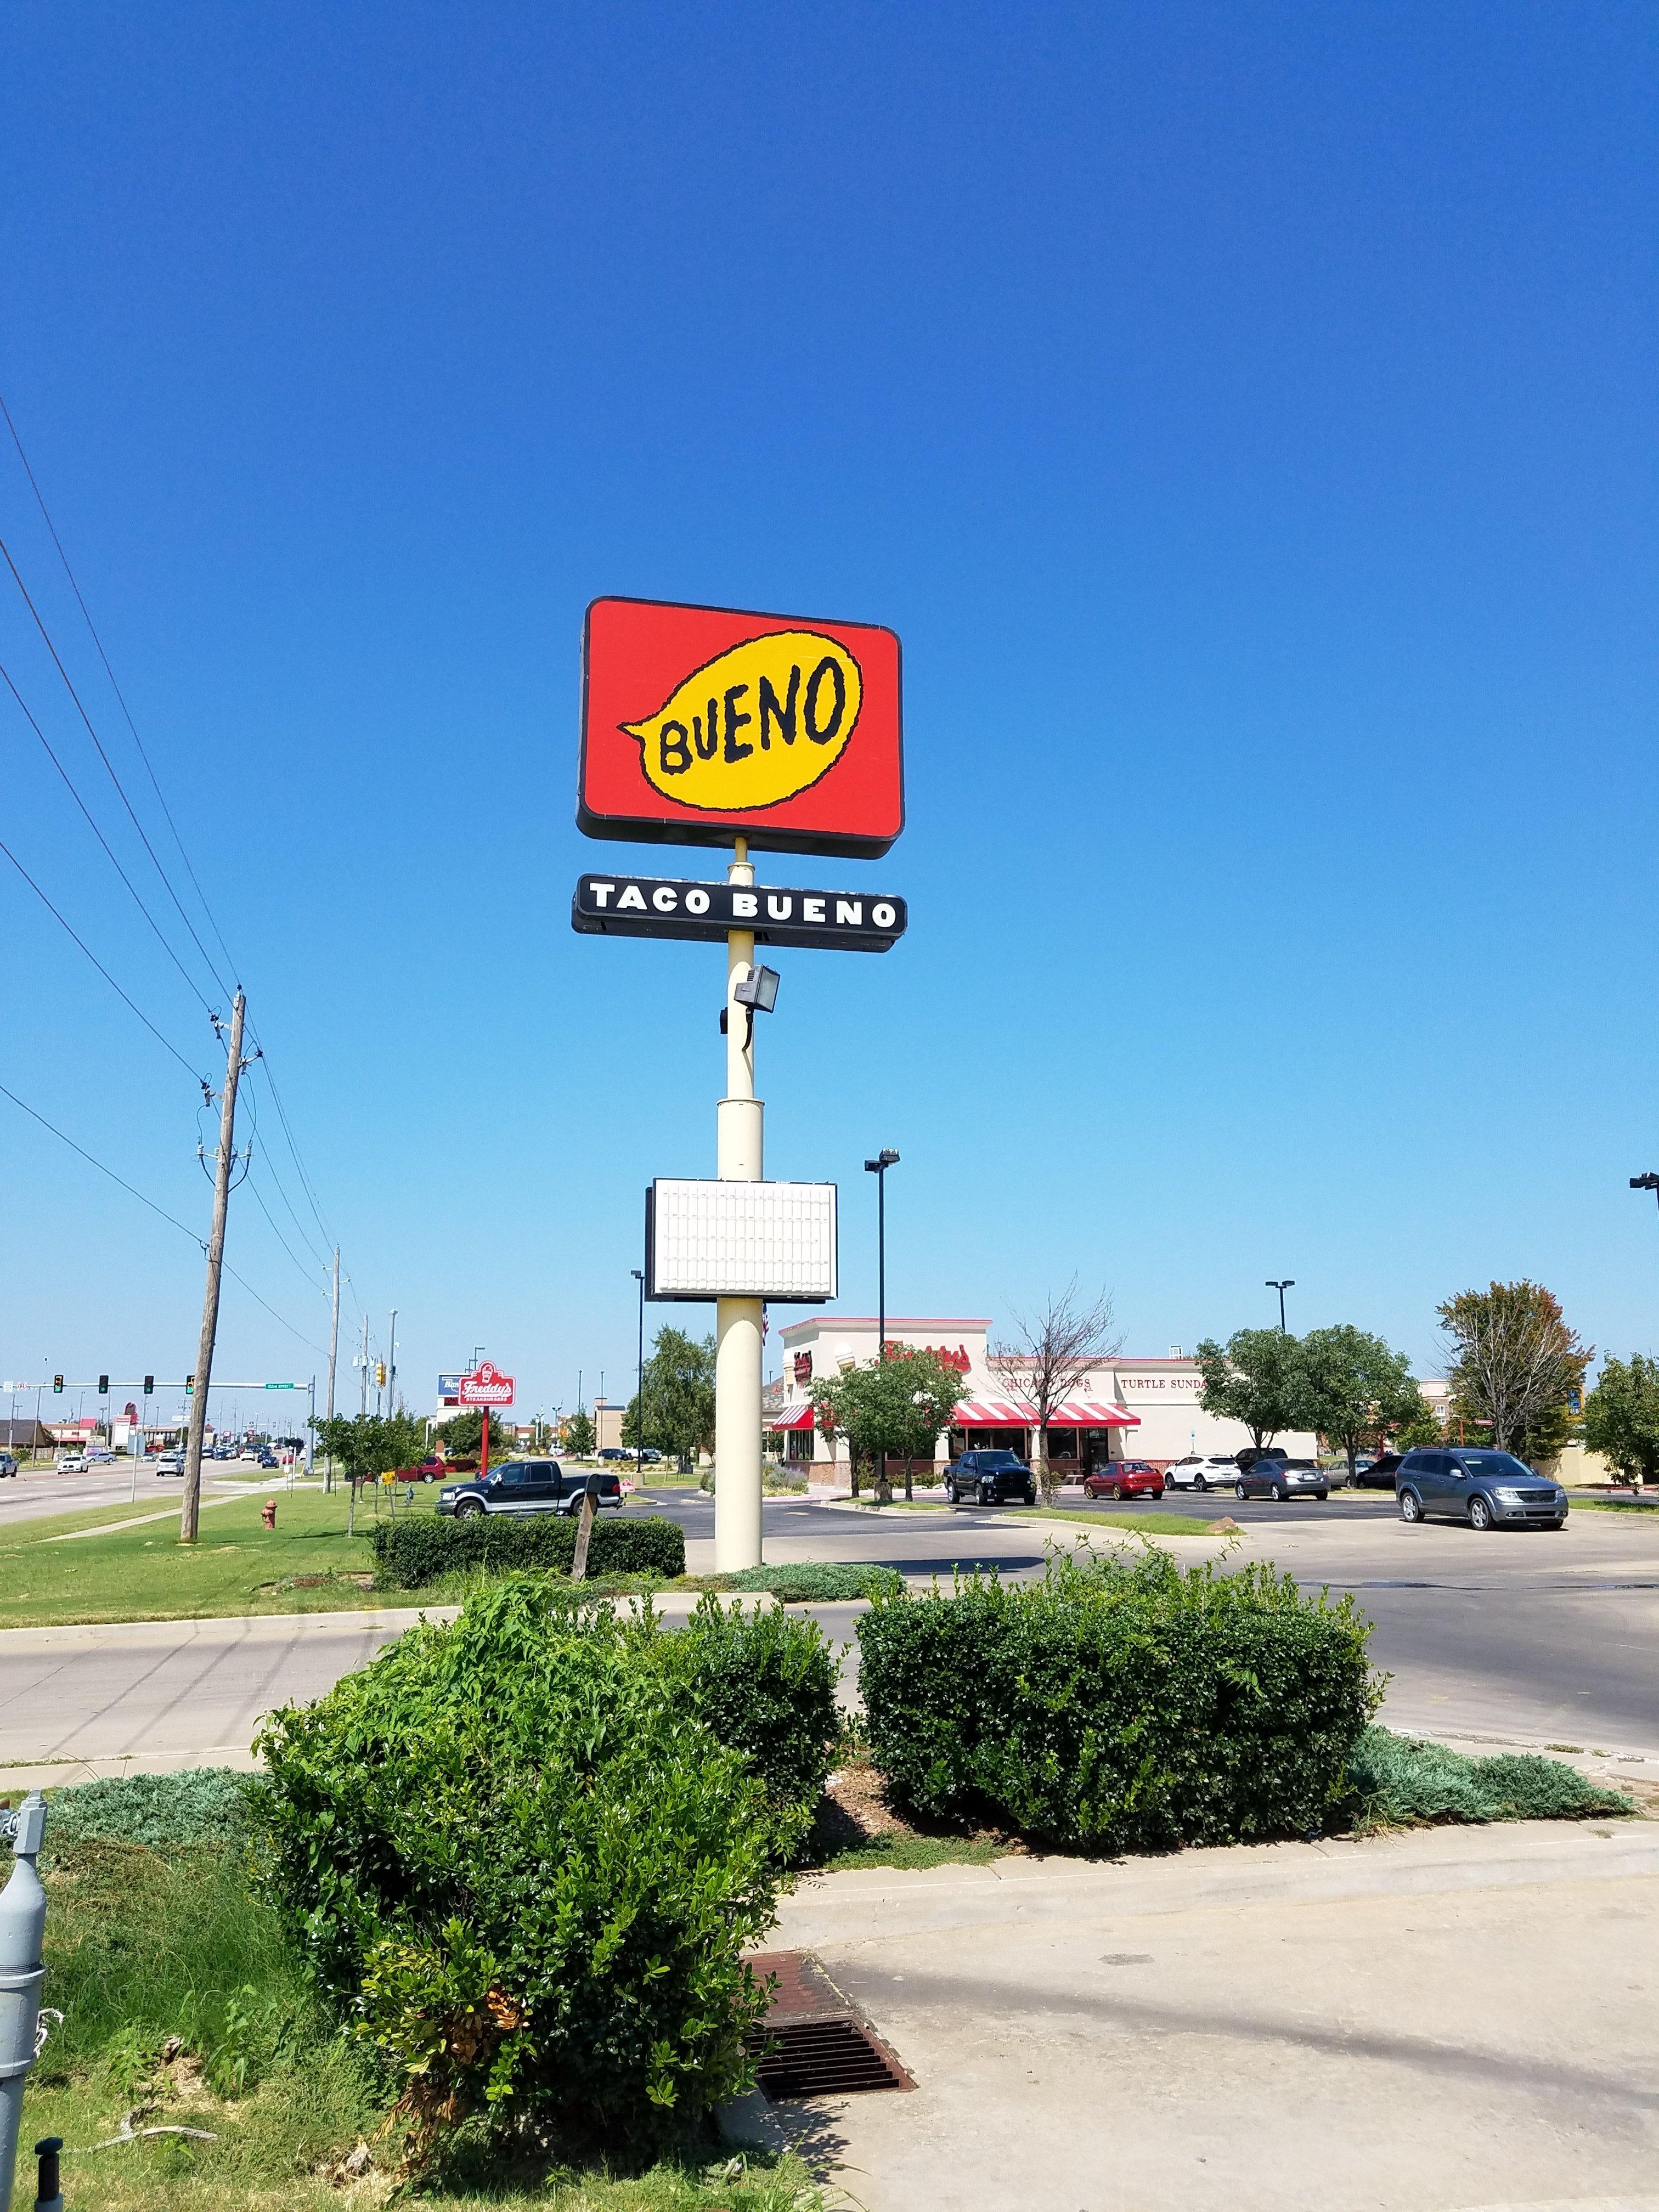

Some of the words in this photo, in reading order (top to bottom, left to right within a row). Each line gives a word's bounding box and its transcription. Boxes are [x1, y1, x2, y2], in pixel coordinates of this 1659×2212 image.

[660, 656, 845, 775] BUENO
[589, 882, 710, 915] TACO
[732, 892, 896, 928] BUENO
[461, 1381, 512, 1397] Freddy's
[1121, 1379, 1166, 1389] TURTLE
